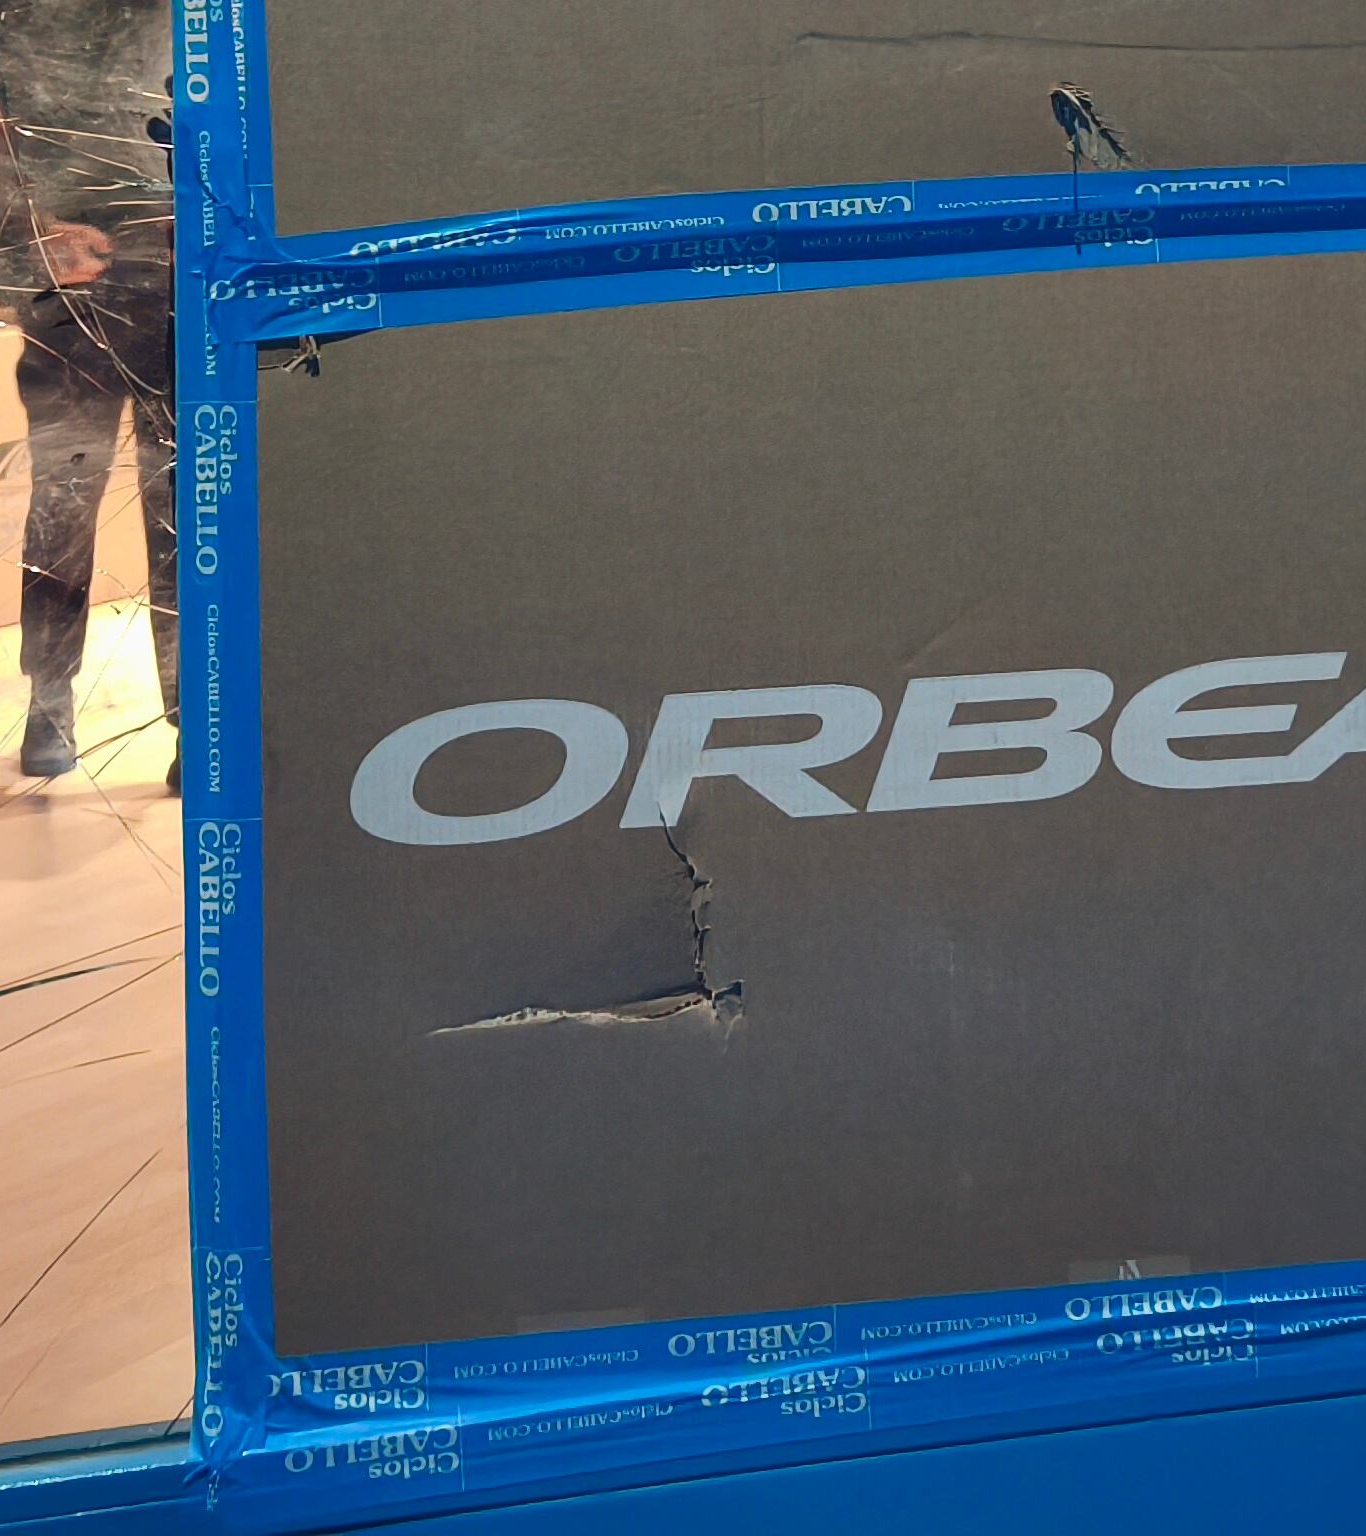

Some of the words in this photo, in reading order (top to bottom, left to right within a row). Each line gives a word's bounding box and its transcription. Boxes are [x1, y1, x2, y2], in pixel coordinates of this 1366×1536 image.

[752, 195, 914, 224] CABELLO
[217, 403, 239, 496] Ciclos
[193, 402, 218, 576] CABELLO
[206, 603, 223, 792] CiclosCABELLO.COM
[221, 822, 243, 915] Ciclos
[199, 821, 221, 997] CABELLO
[223, 1251, 245, 1348] Ciclos
[1063, 1285, 1225, 1322] CABELLO
[200, 1250, 225, 1438] CABELLO
[667, 1320, 834, 1358] CABELLO
[333, 1385, 426, 1414] Ciclos
[779, 1388, 869, 1419] Ciclos
[284, 1424, 461, 1474] CABELLO
[368, 1450, 461, 1481] Ciclos
